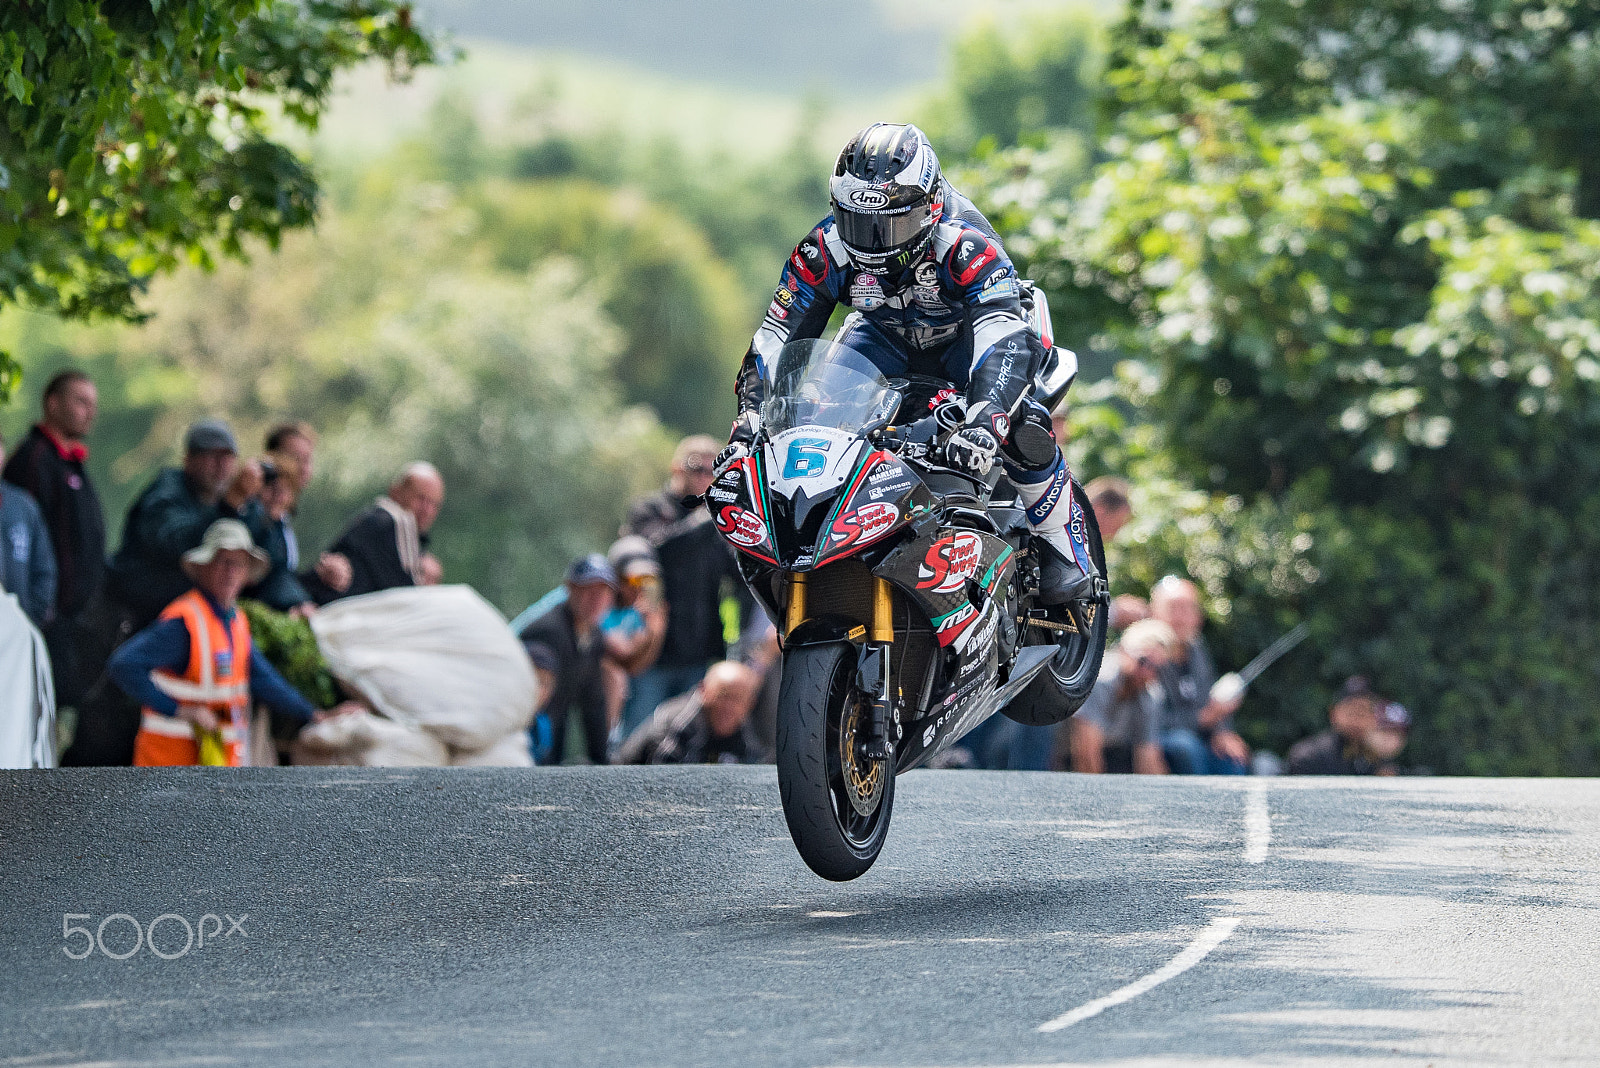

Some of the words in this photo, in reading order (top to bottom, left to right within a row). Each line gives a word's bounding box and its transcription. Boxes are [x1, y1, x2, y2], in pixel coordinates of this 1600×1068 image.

[856, 192, 881, 203] Arai
[878, 206, 905, 215] WINDOWS
[881, 391, 899, 420] Dunlop
[782, 437, 832, 480] 6
[868, 466, 902, 482] MARLOW
[869, 482, 911, 500] Robinson
[1034, 469, 1064, 517] daytona
